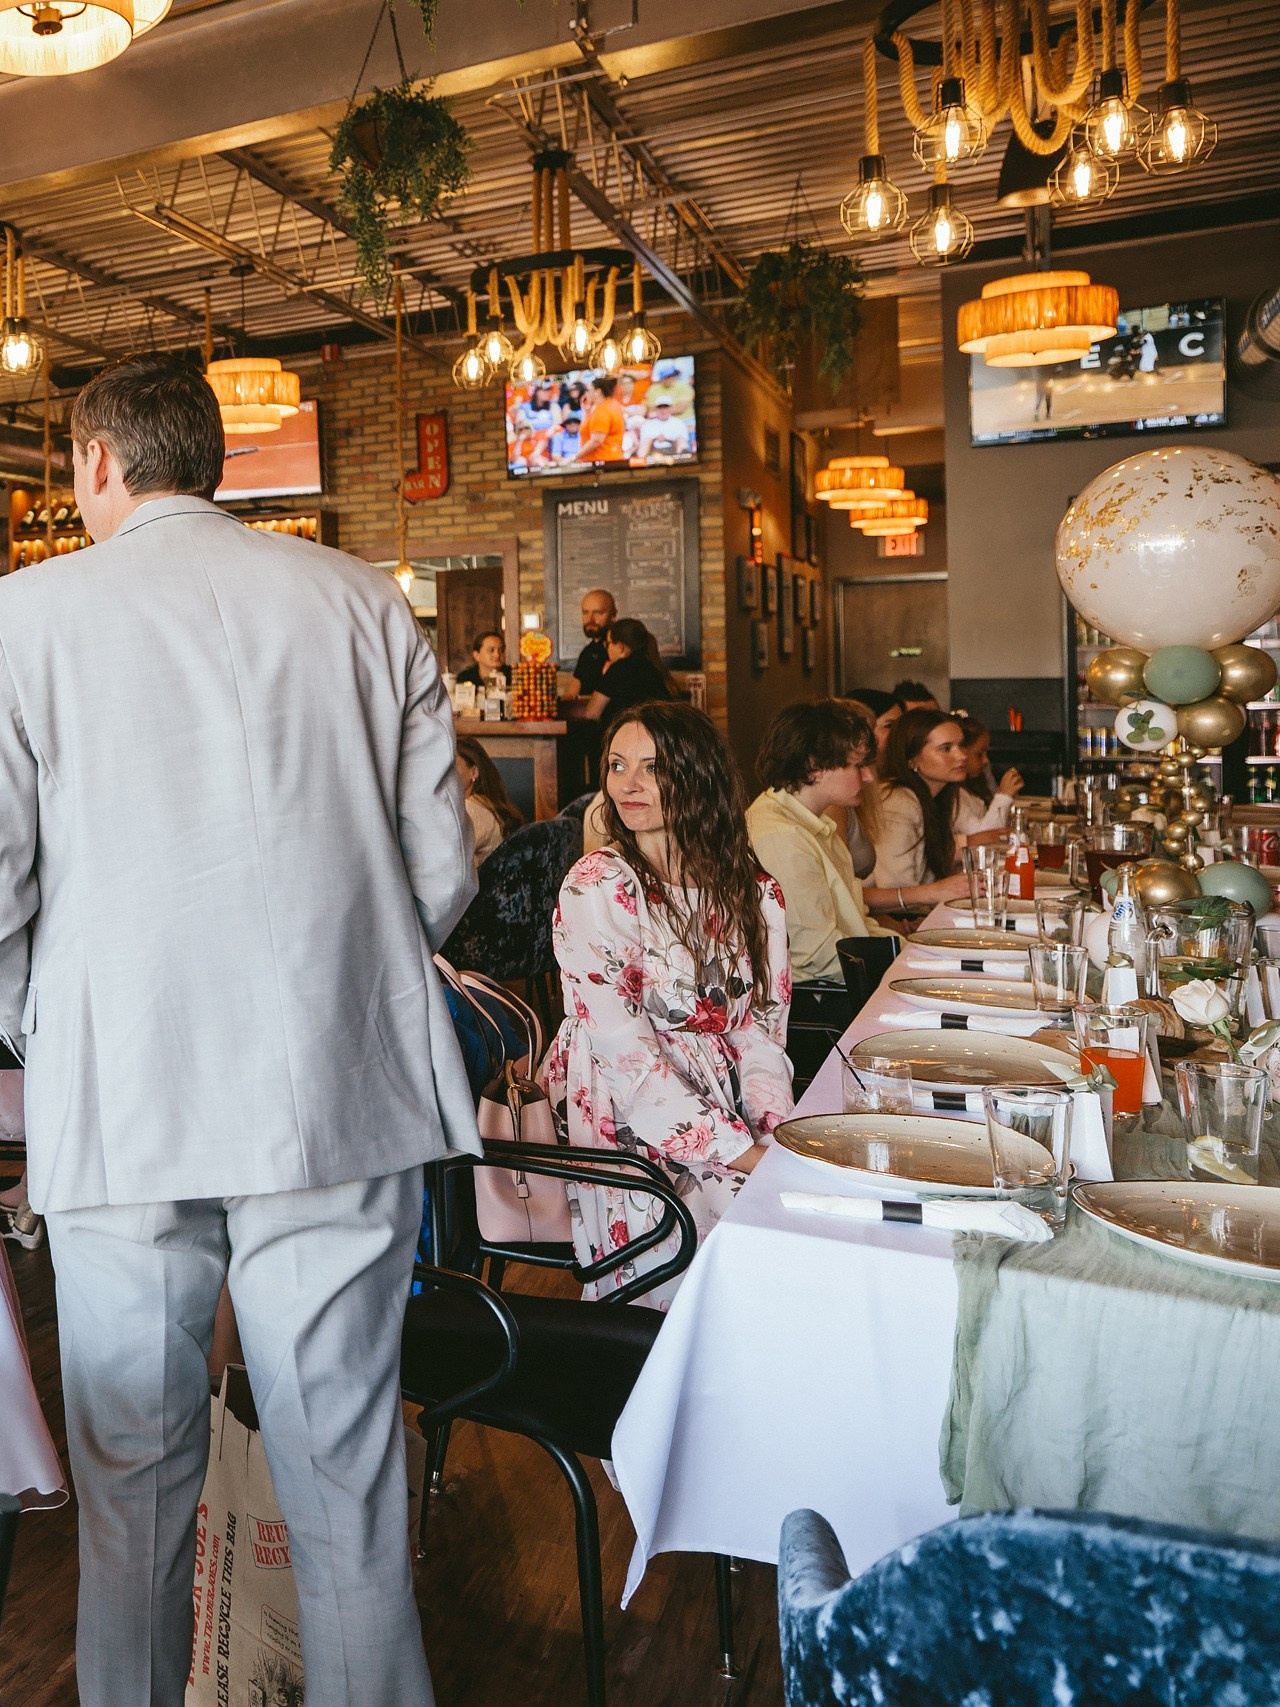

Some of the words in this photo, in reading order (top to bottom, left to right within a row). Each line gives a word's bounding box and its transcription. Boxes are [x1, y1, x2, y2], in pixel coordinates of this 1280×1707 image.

[425, 424, 441, 488] OPEN
[558, 500, 609, 515] MENU
[194, 1503, 208, 1576] JOES
[225, 1511, 237, 1546] BAG
[221, 1546, 234, 1585] THIS
[217, 1587, 232, 1661] RECYCLE
